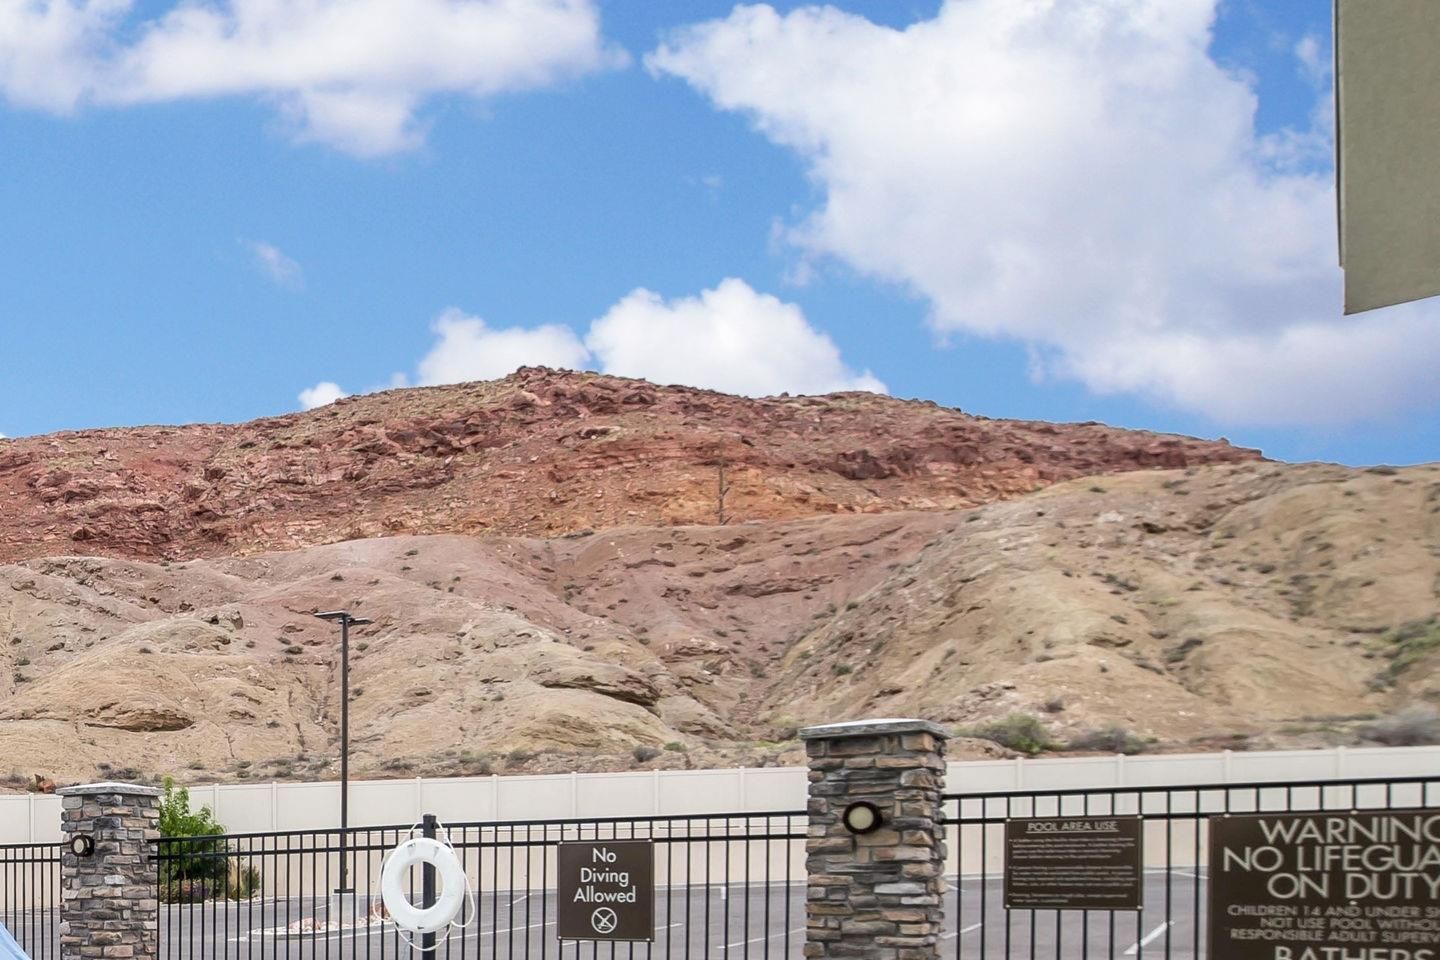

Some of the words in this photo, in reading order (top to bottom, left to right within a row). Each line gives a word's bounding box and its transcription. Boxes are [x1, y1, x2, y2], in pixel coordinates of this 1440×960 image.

[1028, 822, 1057, 831] POOL
[1062, 822, 1092, 831] AREA
[1095, 821, 1118, 830] USE
[593, 847, 616, 862] No
[1223, 846, 1283, 872] NO
[581, 867, 629, 887] Diving
[1267, 873, 1329, 898] ON
[1345, 872, 1440, 899] DUTY
[573, 885, 635, 902] Allowed
[1227, 905, 1297, 916] CHILDREN
[1304, 905, 1320, 916] 14
[1324, 906, 1361, 917] AND
[1364, 906, 1420, 918] UNDER
[1261, 917, 1292, 928] NOT
[1297, 918, 1326, 929] USE
[1330, 918, 1372, 930] POOL
[1230, 928, 1323, 941] RESPONSIBLE
[1328, 930, 1378, 942] ADULT
